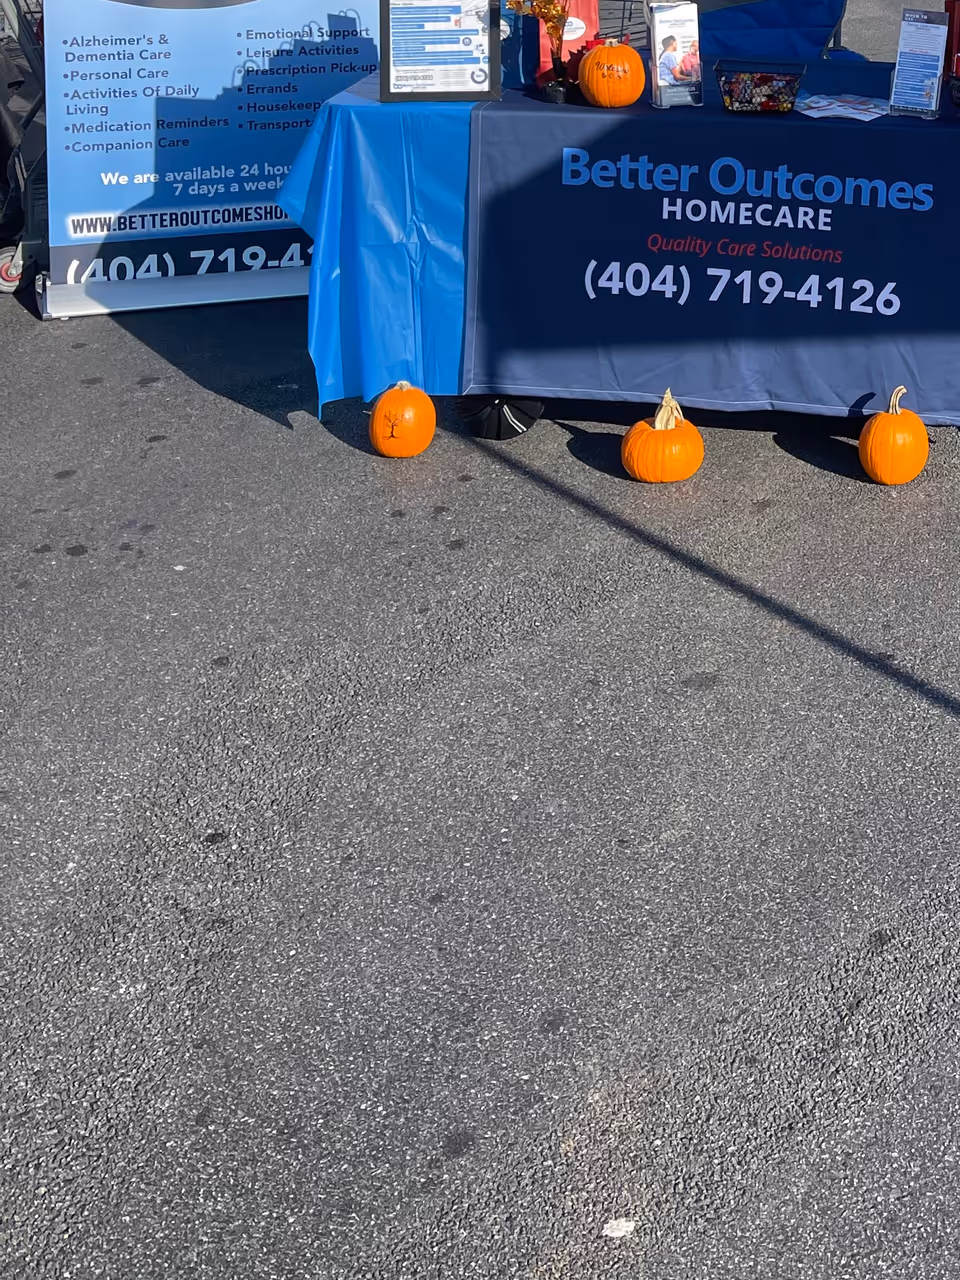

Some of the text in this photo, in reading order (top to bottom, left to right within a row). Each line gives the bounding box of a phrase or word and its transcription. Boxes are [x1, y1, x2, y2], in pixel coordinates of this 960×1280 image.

[69, 34, 169, 47] Alzheimer's &
[246, 27, 370, 40] Emotional Support
[65, 49, 171, 62] Dementia Care
[246, 45, 359, 58] Leisure Activities
[70, 68, 169, 81] Personal Care
[246, 62, 377, 77] Prescription Pick-up
[70, 84, 199, 100] Activities Of Daily
[247, 82, 298, 94] Errands
[66, 104, 109, 116] Living
[71, 116, 229, 134] Medication Reminders
[247, 119, 314, 131] Transport
[72, 137, 189, 153] Companion Care
[101, 172, 128, 185] We
[134, 173, 159, 184] are
[165, 167, 235, 182] available
[241, 164, 259, 177] 24
[562, 147, 934, 211] Better Outcomes
[173, 176, 284, 197] 7 days a week
[662, 197, 832, 231] HOMECARE
[647, 233, 843, 264] Quality Care Solutions
[67, 252, 175, 285] (404)
[584, 259, 901, 316] (404) 719-4126
